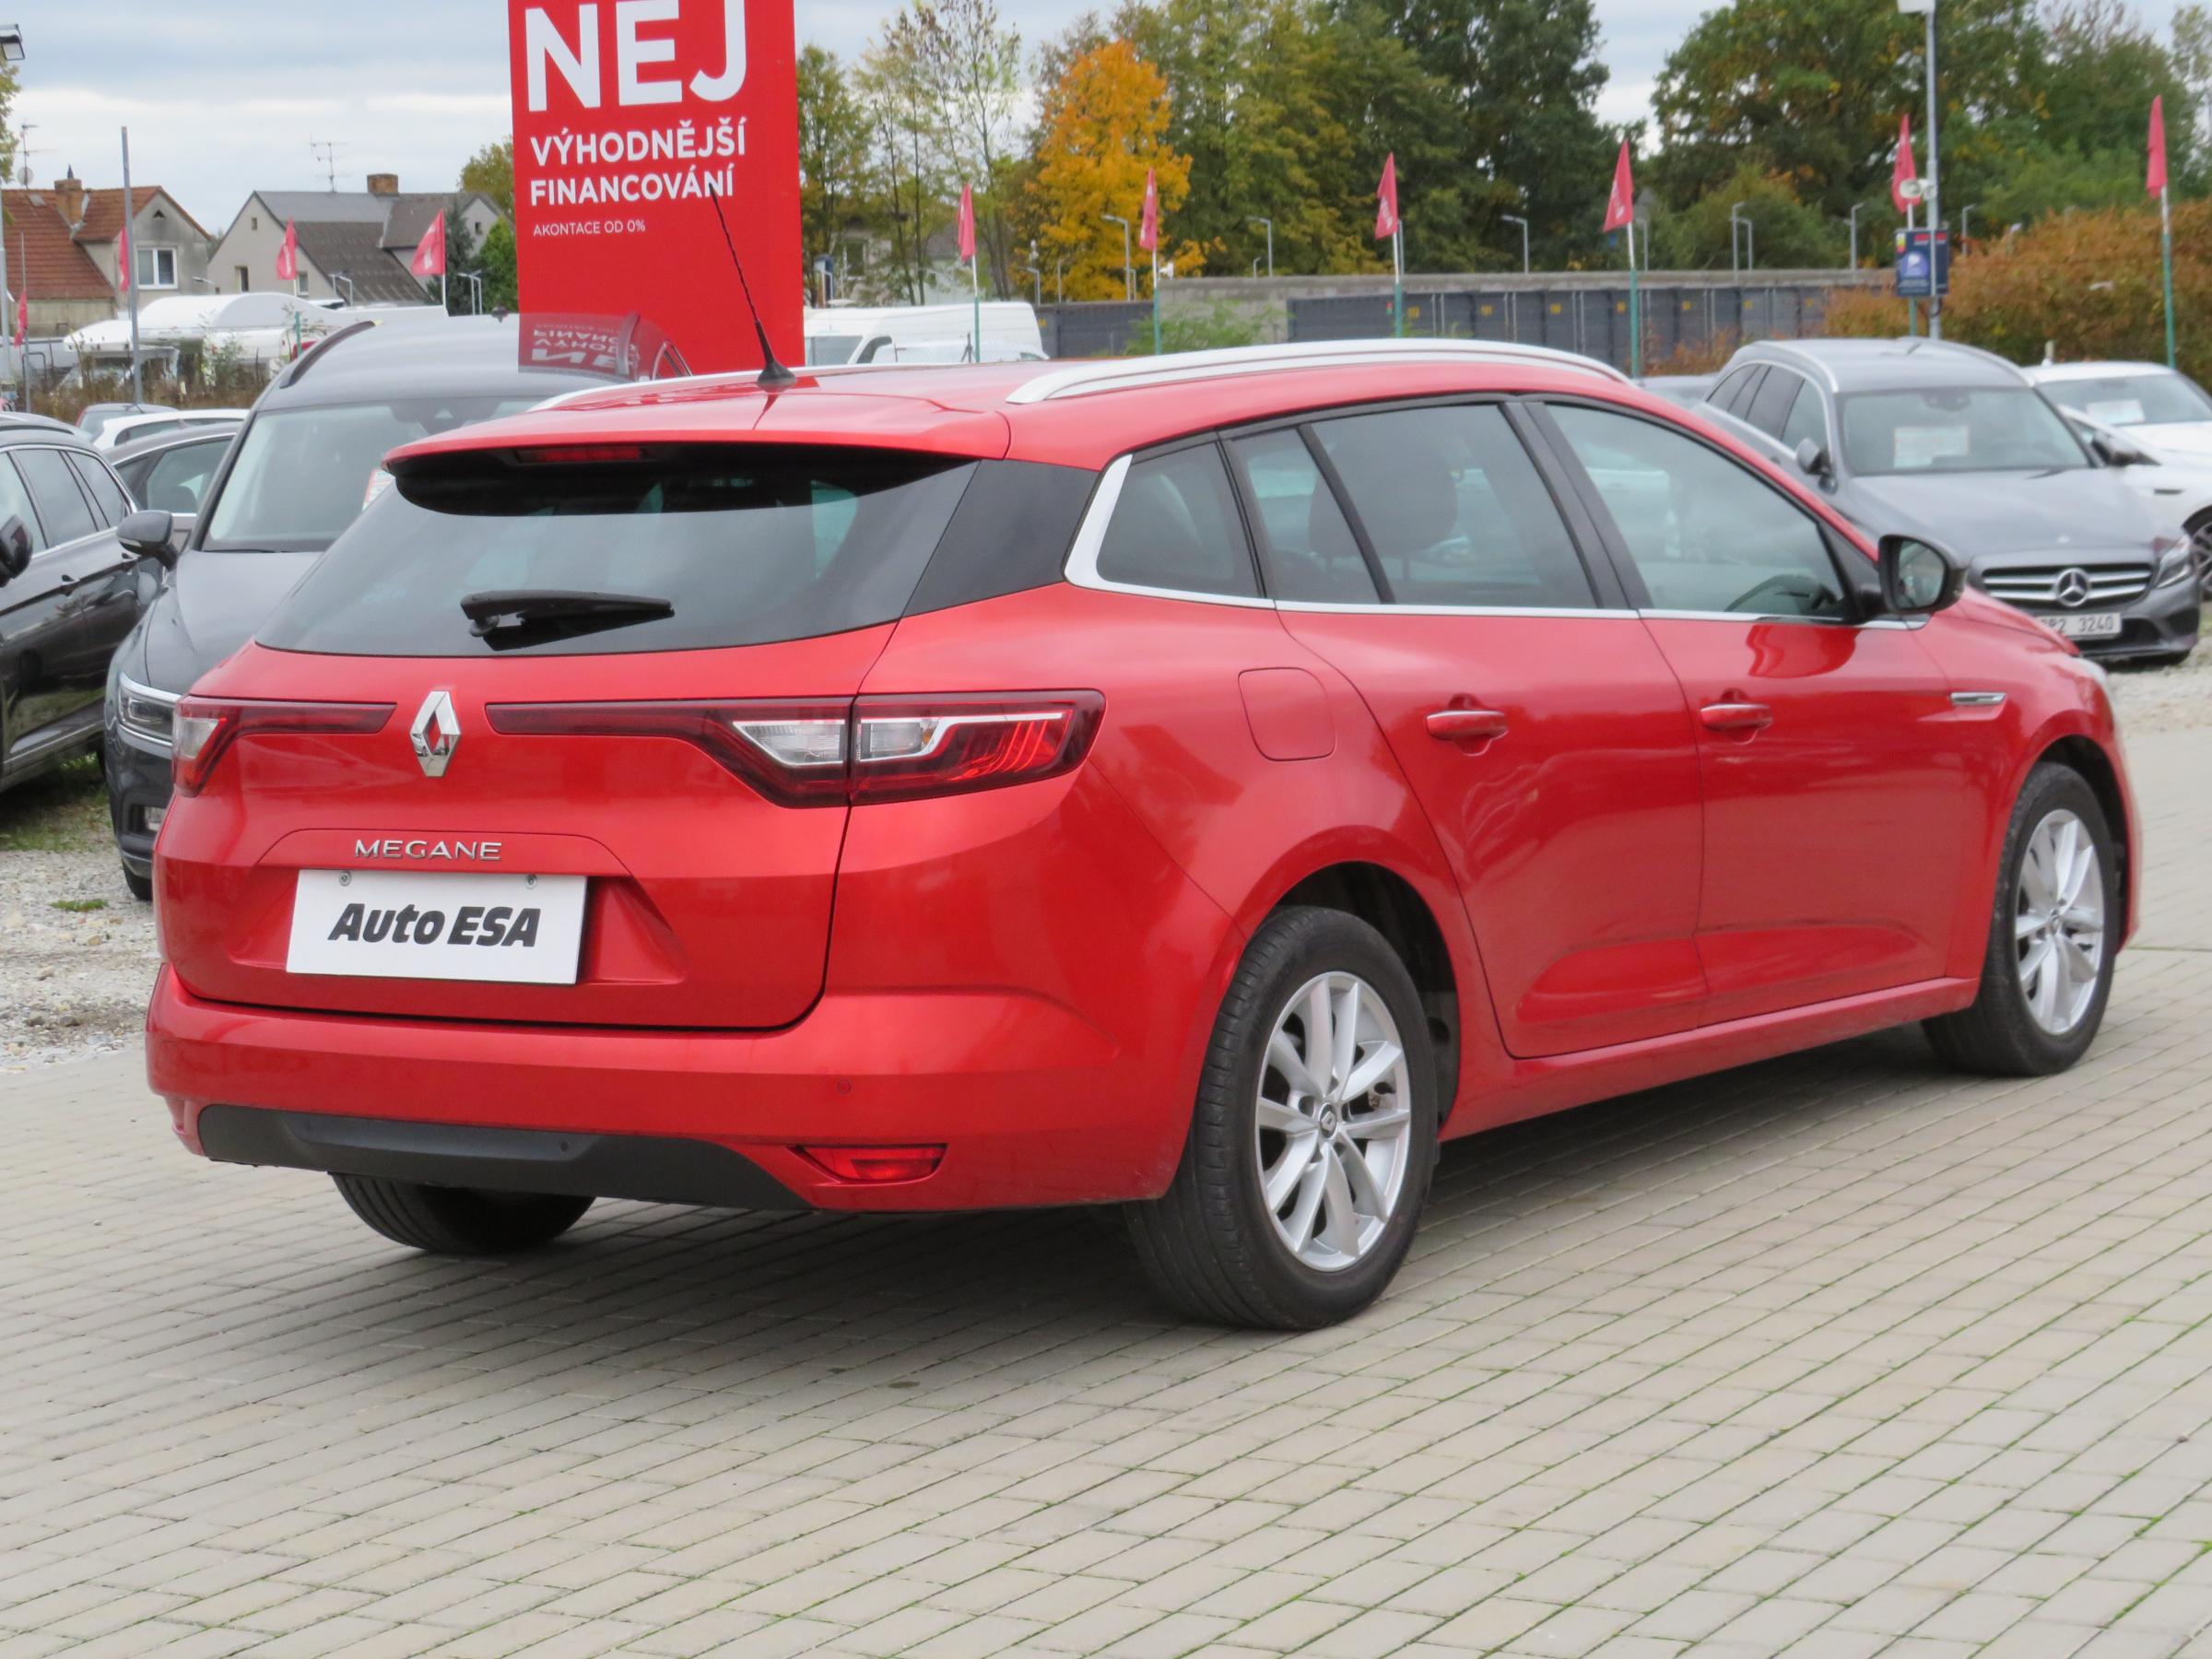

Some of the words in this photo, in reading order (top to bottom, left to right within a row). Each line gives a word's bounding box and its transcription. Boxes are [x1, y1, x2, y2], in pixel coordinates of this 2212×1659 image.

[525, 0, 747, 112] NEJ
[530, 117, 747, 167] VÝHODNĚJŠÍ
[530, 163, 735, 206] FINANCOVÁNÍ
[533, 220, 601, 237] AKONTACE
[604, 220, 624, 234] OD
[627, 218, 646, 233] 0%
[2078, 615, 2114, 632] 3240
[354, 839, 502, 862] MEGANE
